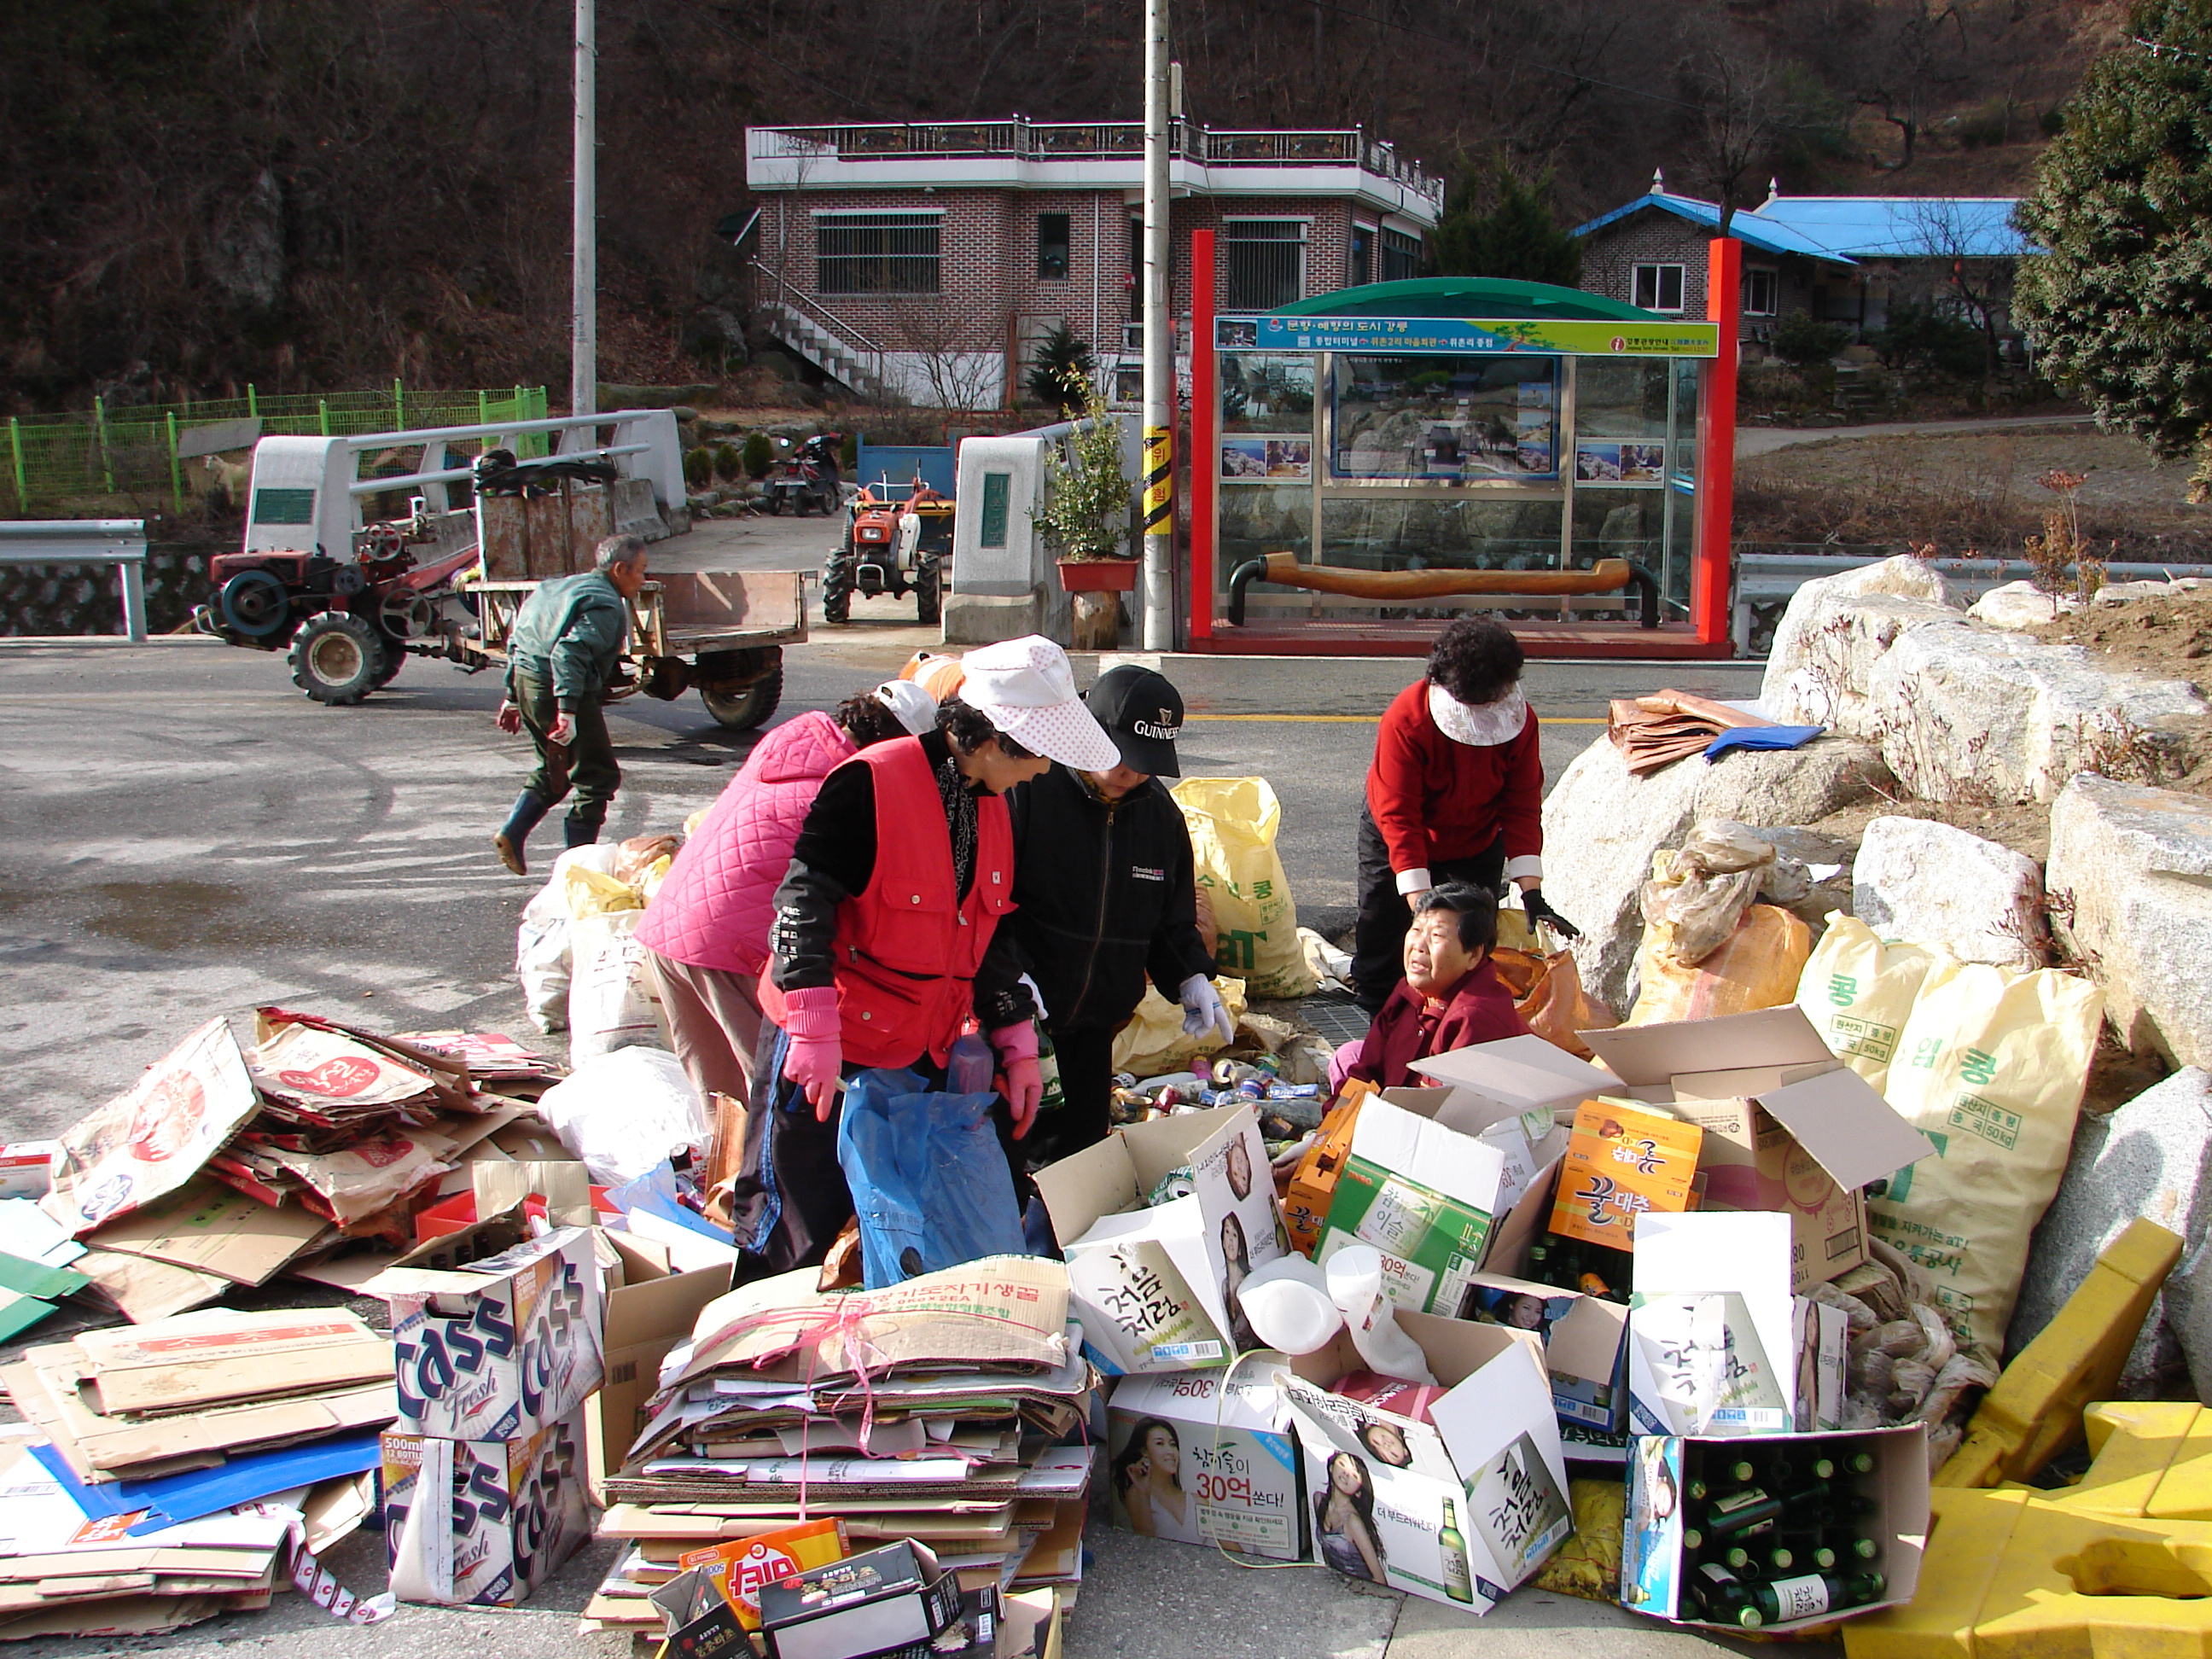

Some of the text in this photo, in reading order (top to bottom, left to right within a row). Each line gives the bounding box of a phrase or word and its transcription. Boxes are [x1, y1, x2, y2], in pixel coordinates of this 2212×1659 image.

[1357, 321, 1381, 332] 도시
[1828, 974, 1857, 1006] 콩
[444, 1366, 498, 1433] Fresh
[1196, 1473, 1252, 1507] 30억
